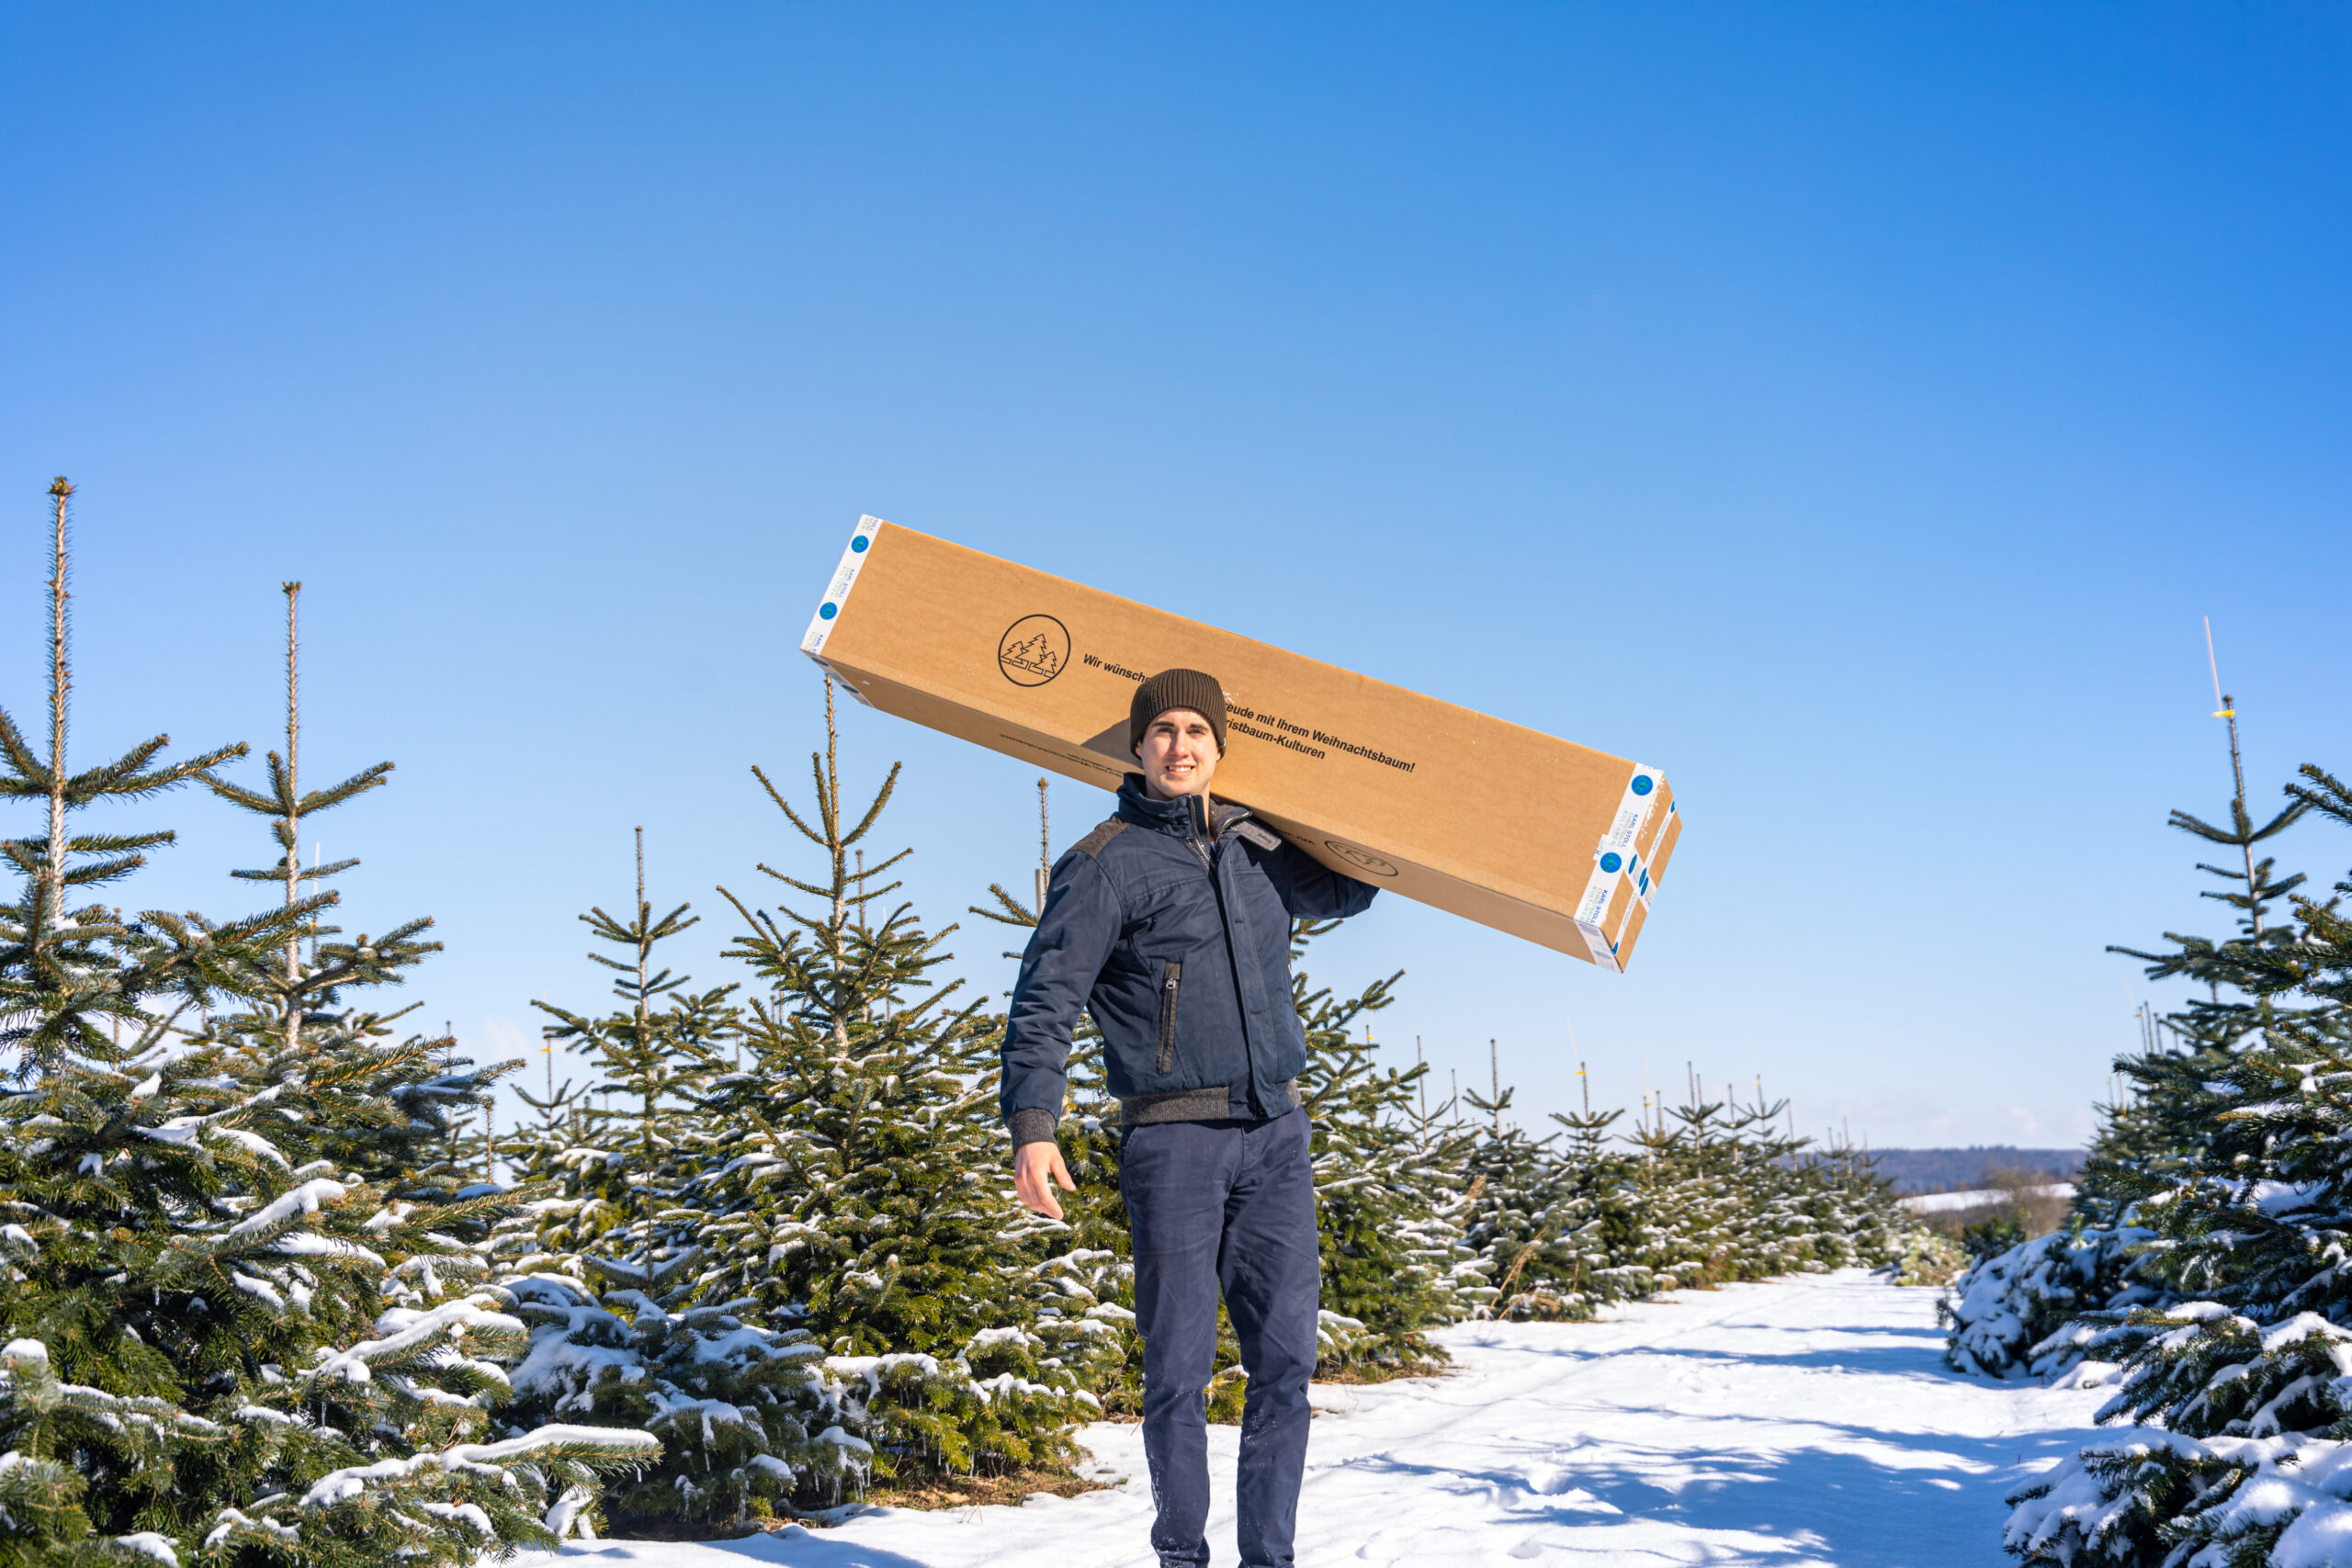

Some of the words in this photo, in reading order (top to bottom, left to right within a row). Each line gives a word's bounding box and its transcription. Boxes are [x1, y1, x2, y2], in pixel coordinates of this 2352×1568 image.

[1083, 653, 1102, 668] Wir
[1256, 714, 1275, 727] mit
[1276, 717, 1309, 738] Ihrem
[1312, 729, 1416, 773] Weihnachtsbaum!
[1629, 814, 1638, 829] KARL
[1621, 829, 1632, 847] STOLL
[1598, 889, 1608, 904] KARL
[1590, 906, 1601, 923] STOLL
